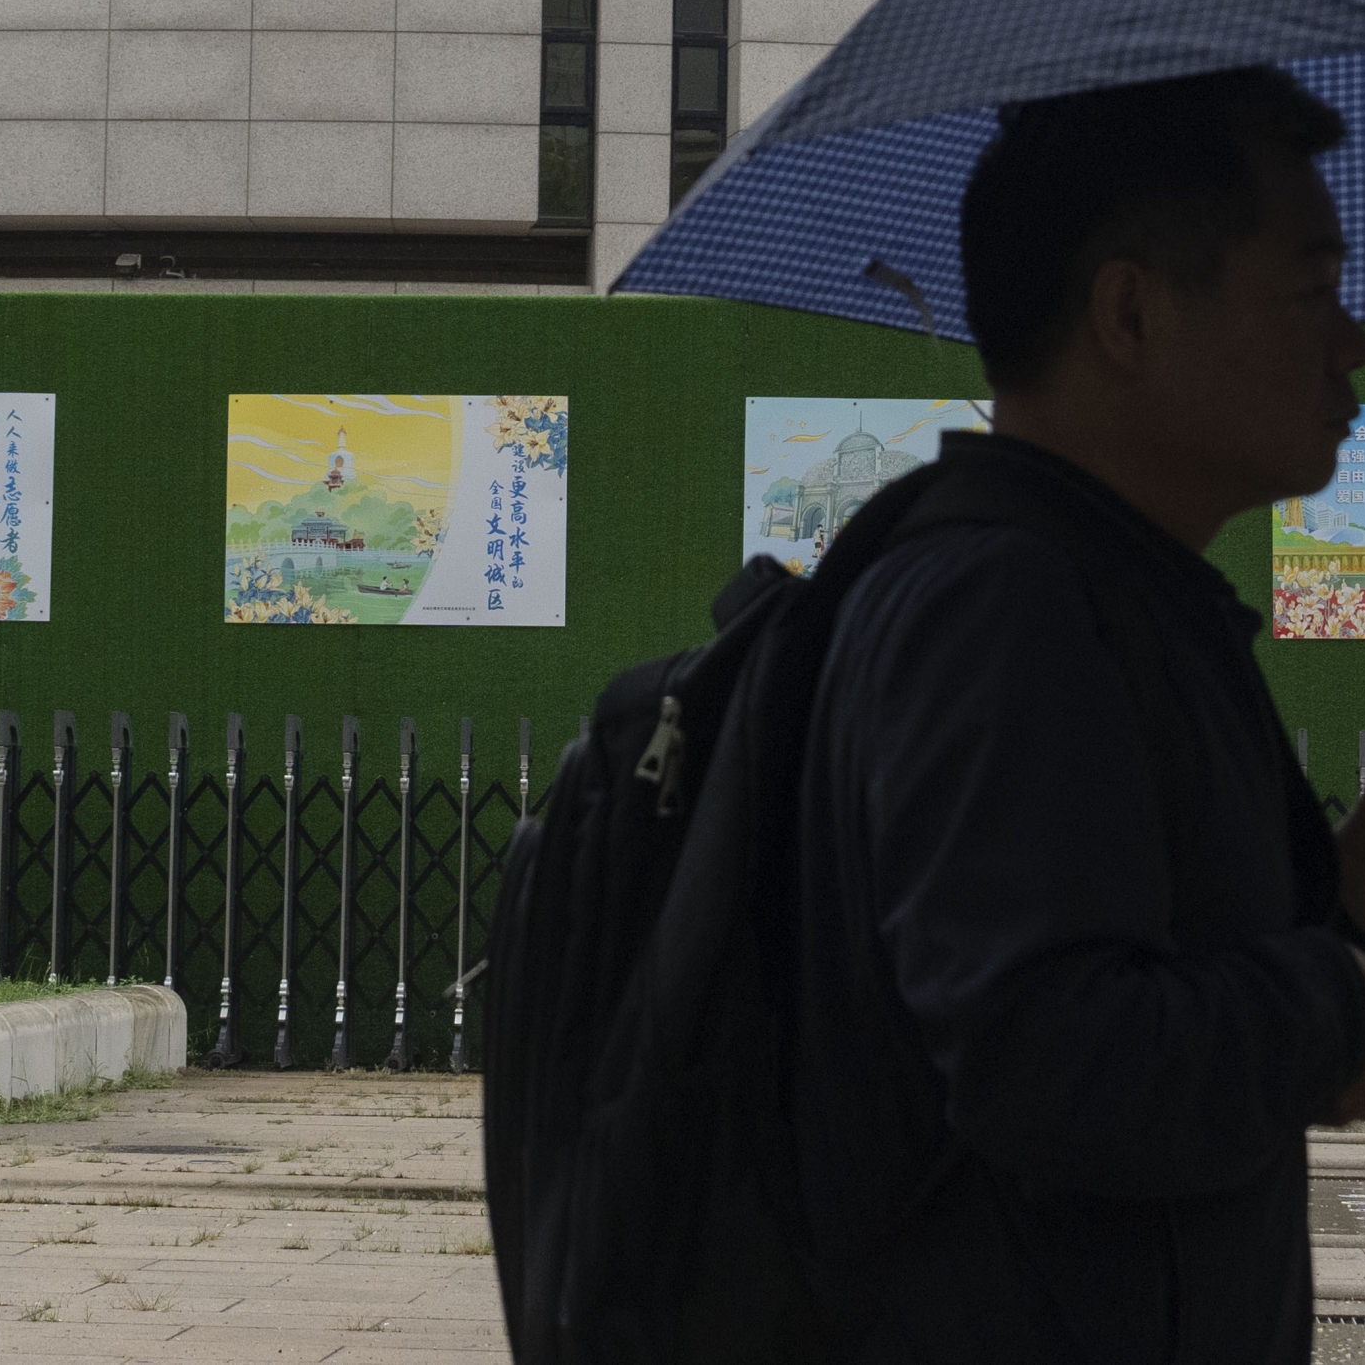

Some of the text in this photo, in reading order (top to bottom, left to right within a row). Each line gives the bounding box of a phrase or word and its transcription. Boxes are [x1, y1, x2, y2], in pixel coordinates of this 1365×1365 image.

[0, 408, 23, 554] 人人来做志愿者
[1337, 449, 1365, 463] 富强
[1337, 469, 1365, 484] 自由
[508, 443, 529, 589] 建设更高水平的
[1337, 490, 1365, 504] 爱国
[483, 479, 508, 611] 全国文明城区
